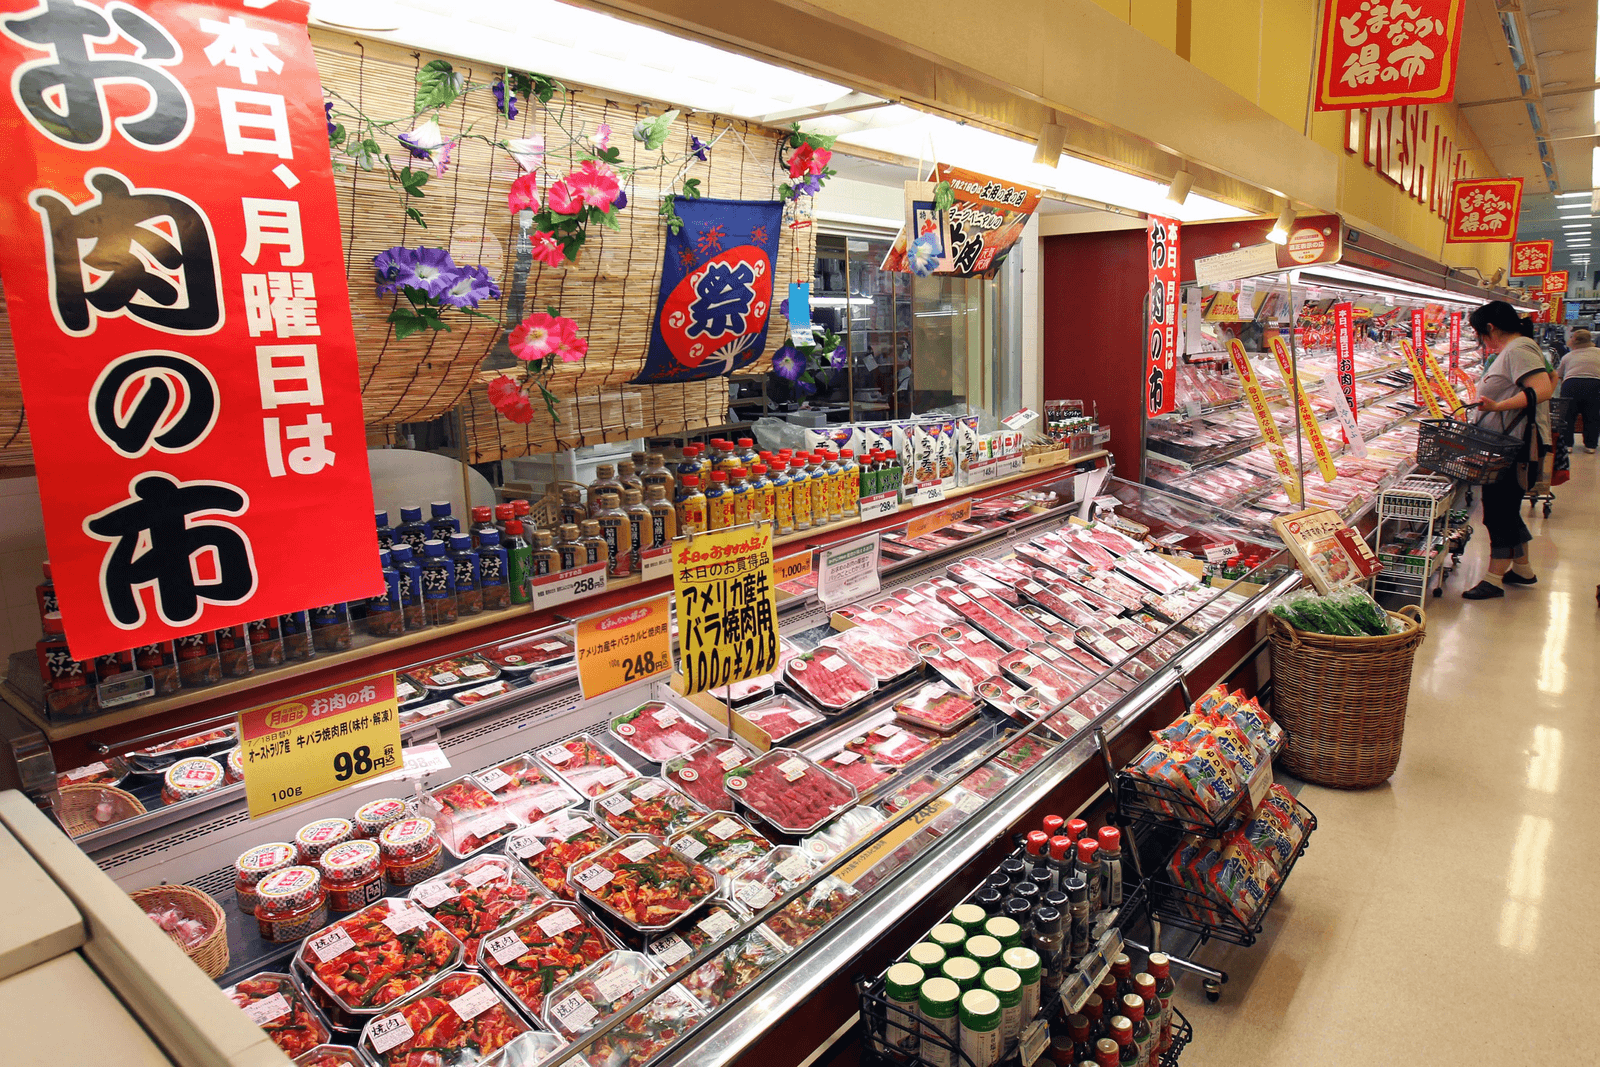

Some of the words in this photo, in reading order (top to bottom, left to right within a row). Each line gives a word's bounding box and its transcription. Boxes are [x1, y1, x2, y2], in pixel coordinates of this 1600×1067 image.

[1340, 0, 1444, 46] どまんなか
[1460, 189, 1511, 214] どまんなか
[1459, 211, 1507, 234] 得の市
[199, 15, 336, 478] 本日、月曜日は
[685, 259, 757, 340] 祭
[1165, 223, 1178, 370] 本日、月曜日は
[0, 0, 258, 631] お肉の市
[1149, 218, 1166, 414] お肉の市
[653, 517, 664, 548] 焙煎にん
[422, 569, 450, 581] ステーキ
[679, 551, 769, 582] 本日のお買得品
[427, 579, 447, 590] ソース
[682, 570, 769, 616] アメリカ産牛
[686, 598, 773, 650] バラ焼肉用
[579, 622, 668, 660] アメリカ産牛バラカルビ焼肉用
[45, 651, 72, 666] ステー
[52, 662, 82, 677] ソース
[311, 685, 376, 716] お肉の市
[249, 738, 291, 763] オーストラリア産
[271, 786, 303, 802] 100g
[580, 867, 600, 882] 焼肉
[314, 932, 340, 950] 焼肉
[490, 936, 514, 953] 焼肉
[654, 935, 677, 954] 焼肉
[556, 996, 580, 1018] 焼肉
[372, 1016, 400, 1037] 焼肉
